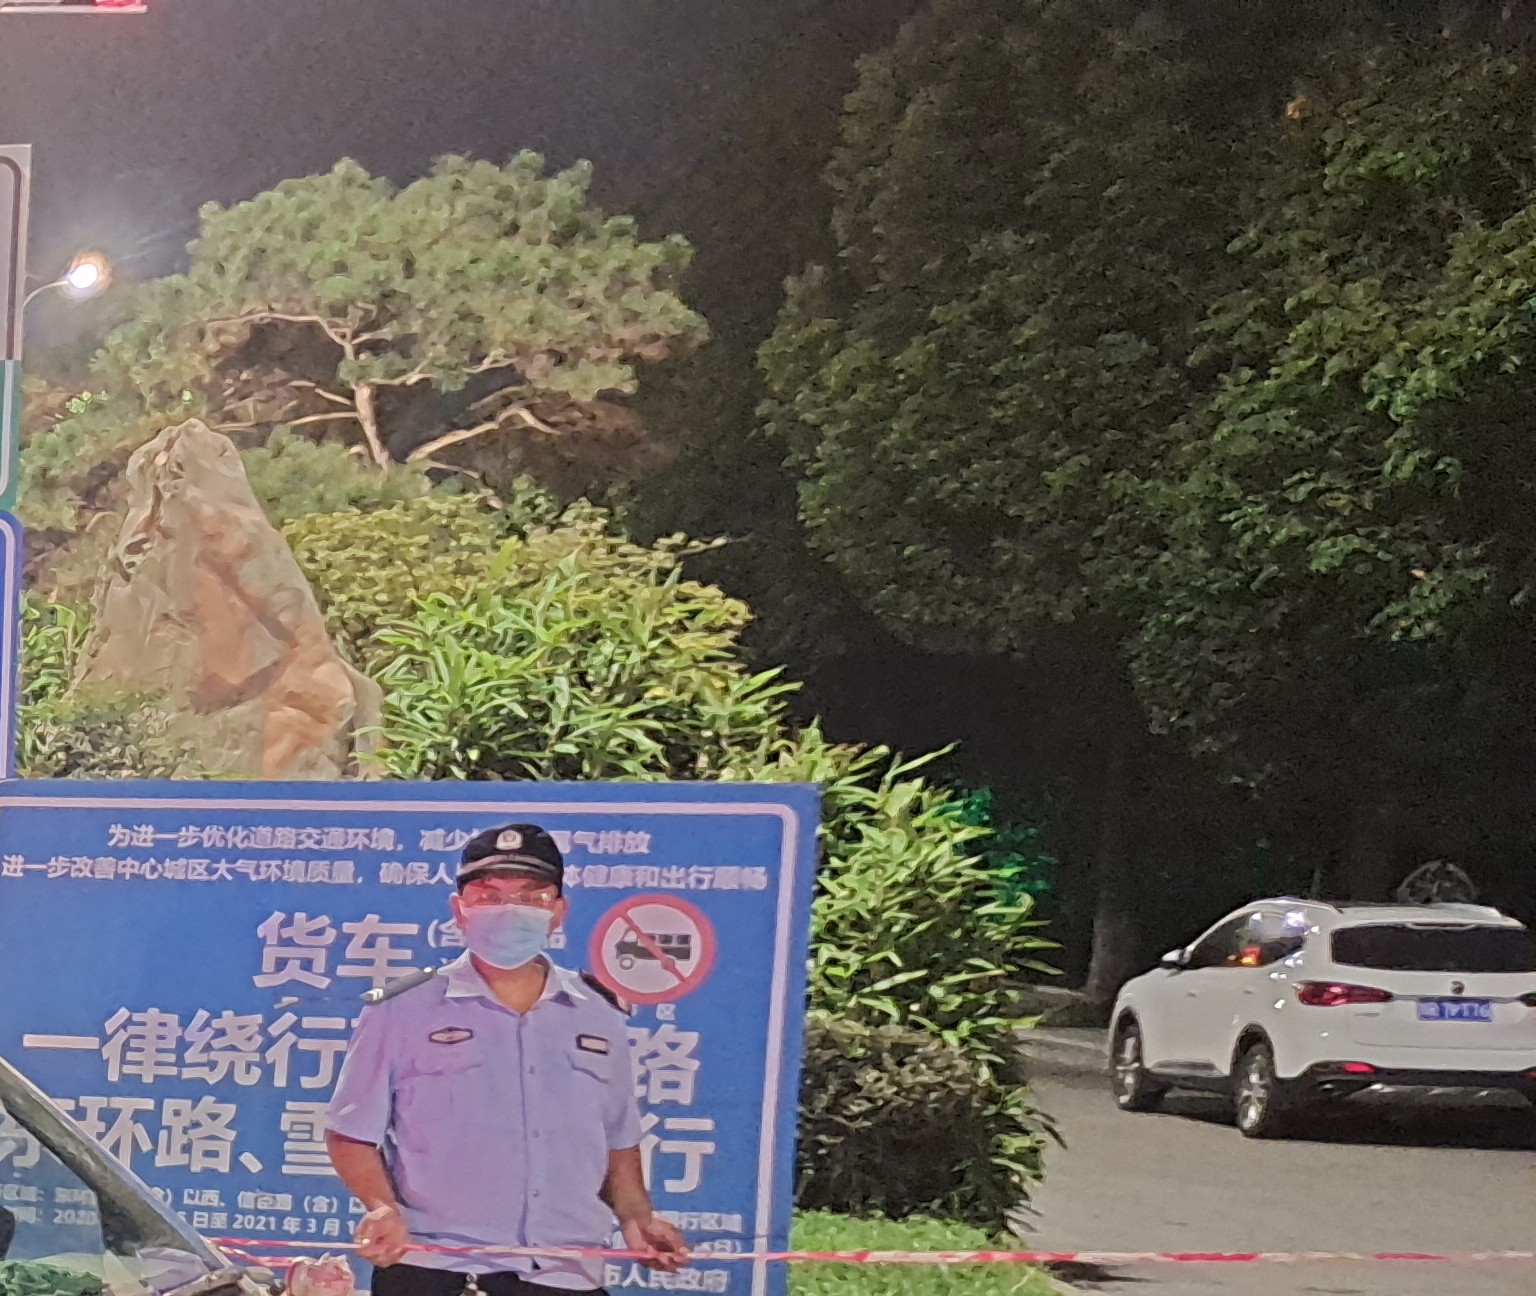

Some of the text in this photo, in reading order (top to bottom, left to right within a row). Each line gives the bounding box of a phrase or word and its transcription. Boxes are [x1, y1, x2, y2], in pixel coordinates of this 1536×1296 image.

[252, 909, 421, 992] 货车
[22, 1006, 701, 1105] 一律绕行 路
[639, 1112, 716, 1193] 行
